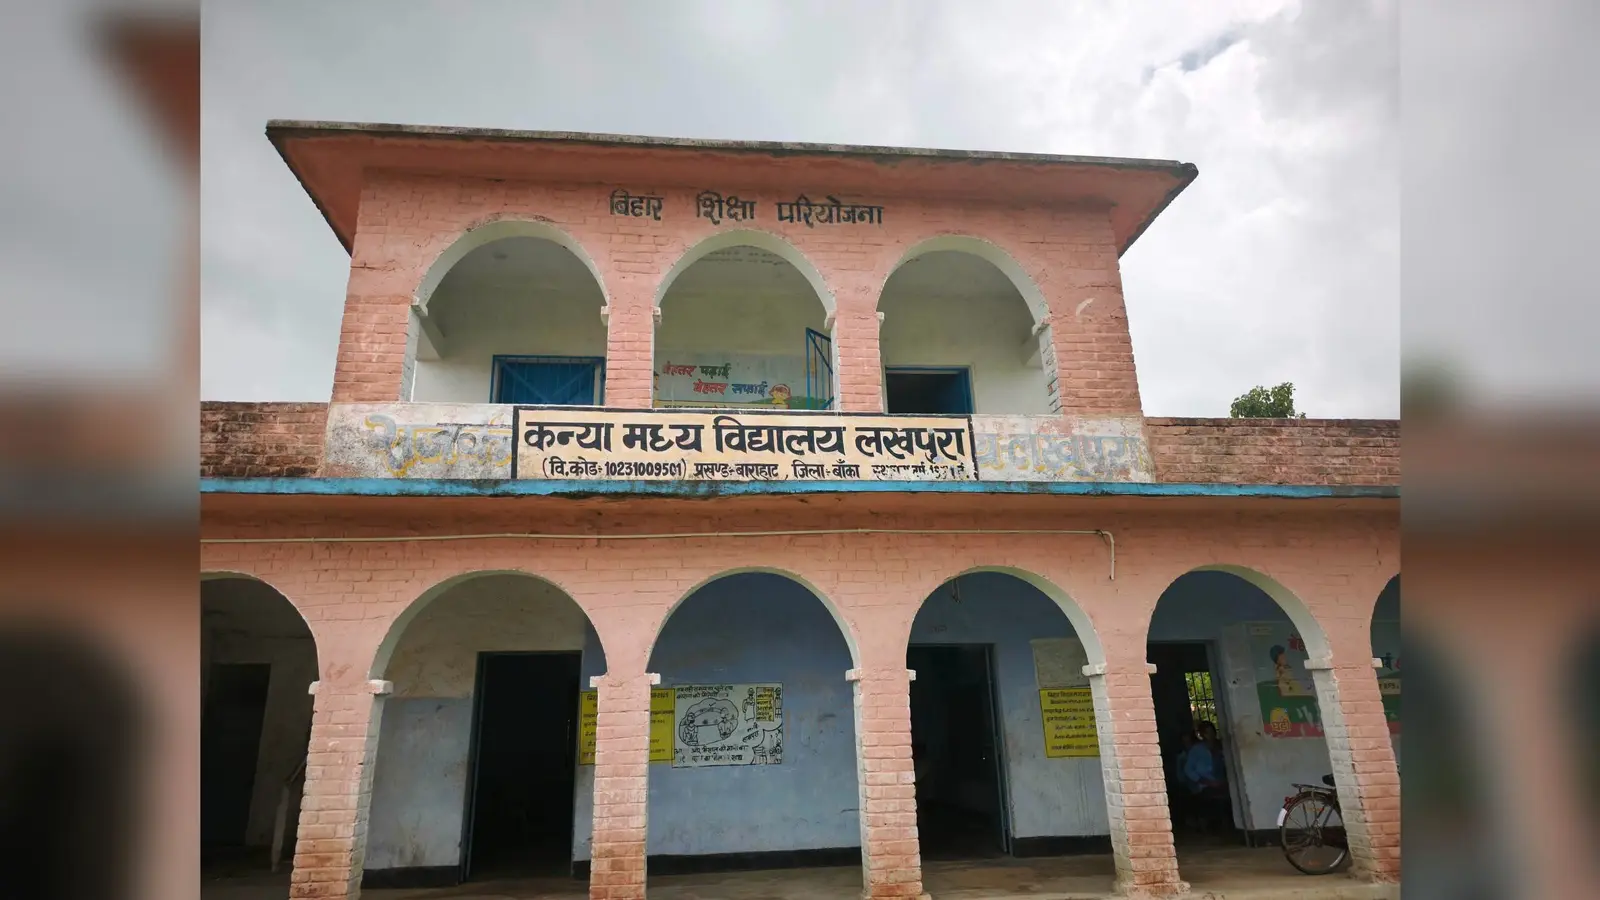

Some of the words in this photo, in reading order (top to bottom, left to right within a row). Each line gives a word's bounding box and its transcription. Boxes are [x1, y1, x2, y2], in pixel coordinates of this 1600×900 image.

[609, 189, 664, 221] बिहार
[696, 190, 756, 225] शिक्षा
[776, 193, 884, 229] परियोजना
[692, 378, 728, 395] बेहतर
[524, 421, 614, 452] कन्या
[622, 424, 704, 453] मध्य
[713, 415, 846, 455] विद्यालय
[855, 427, 965, 462] लखपुरा
